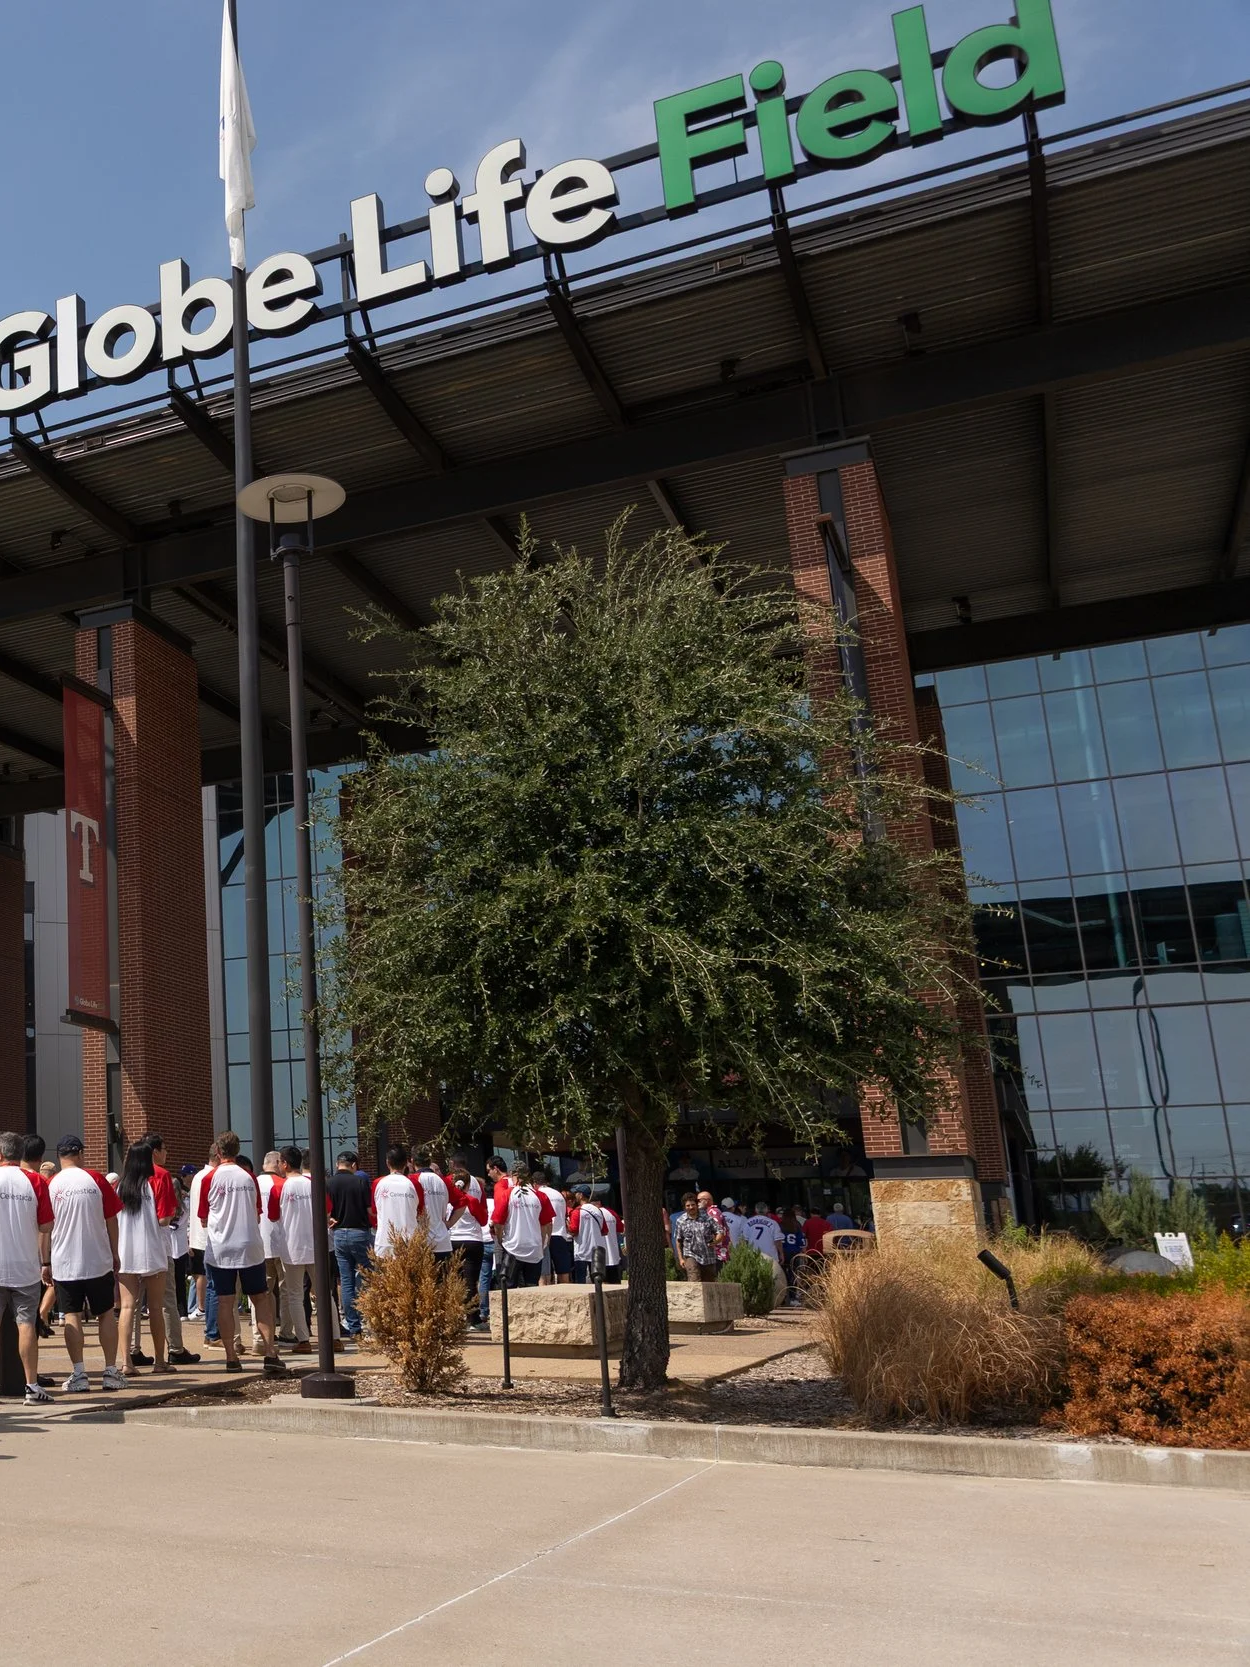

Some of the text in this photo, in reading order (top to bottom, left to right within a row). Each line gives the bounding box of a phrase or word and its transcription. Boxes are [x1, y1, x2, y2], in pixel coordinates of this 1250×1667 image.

[351, 138, 619, 306] Life
[654, 0, 1064, 217] Field
[69, 810, 100, 884] T
[717, 1159, 743, 1168] ALL
[755, 1226, 764, 1241] 7
